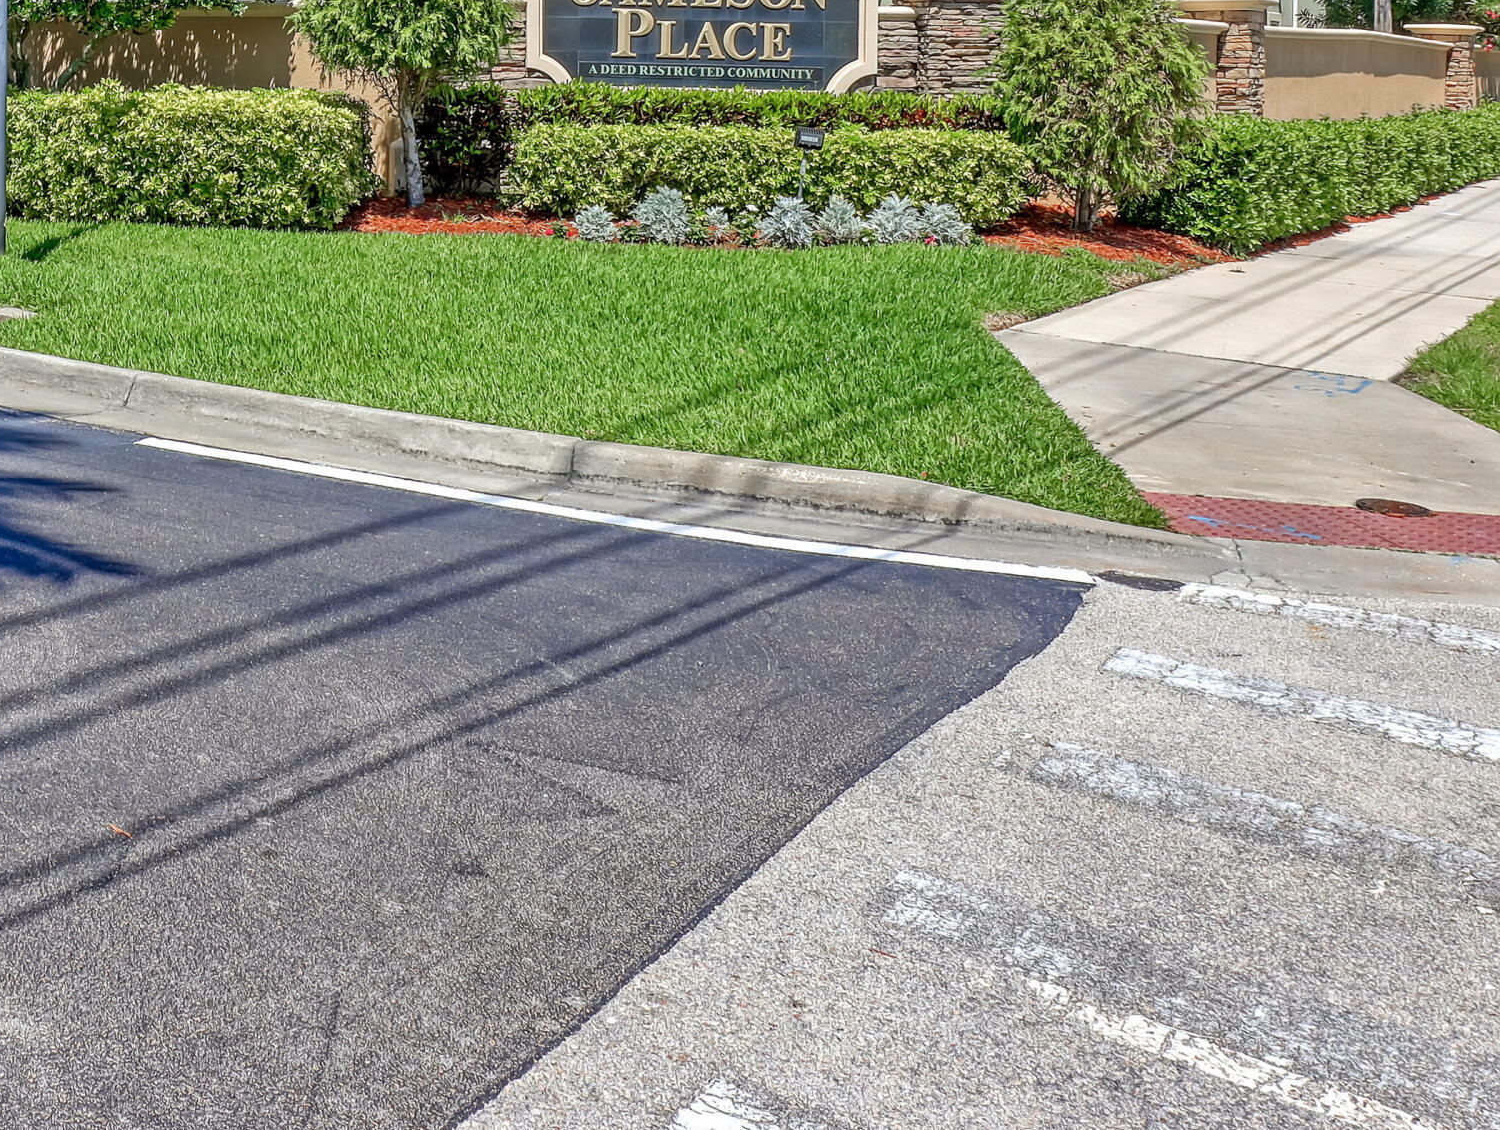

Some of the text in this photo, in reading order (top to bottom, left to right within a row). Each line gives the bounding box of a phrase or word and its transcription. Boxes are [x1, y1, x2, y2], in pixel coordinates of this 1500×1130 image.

[610, 7, 793, 62] PLACE
[588, 64, 814, 80] A DEED RESTRICTED COMMUNITY
